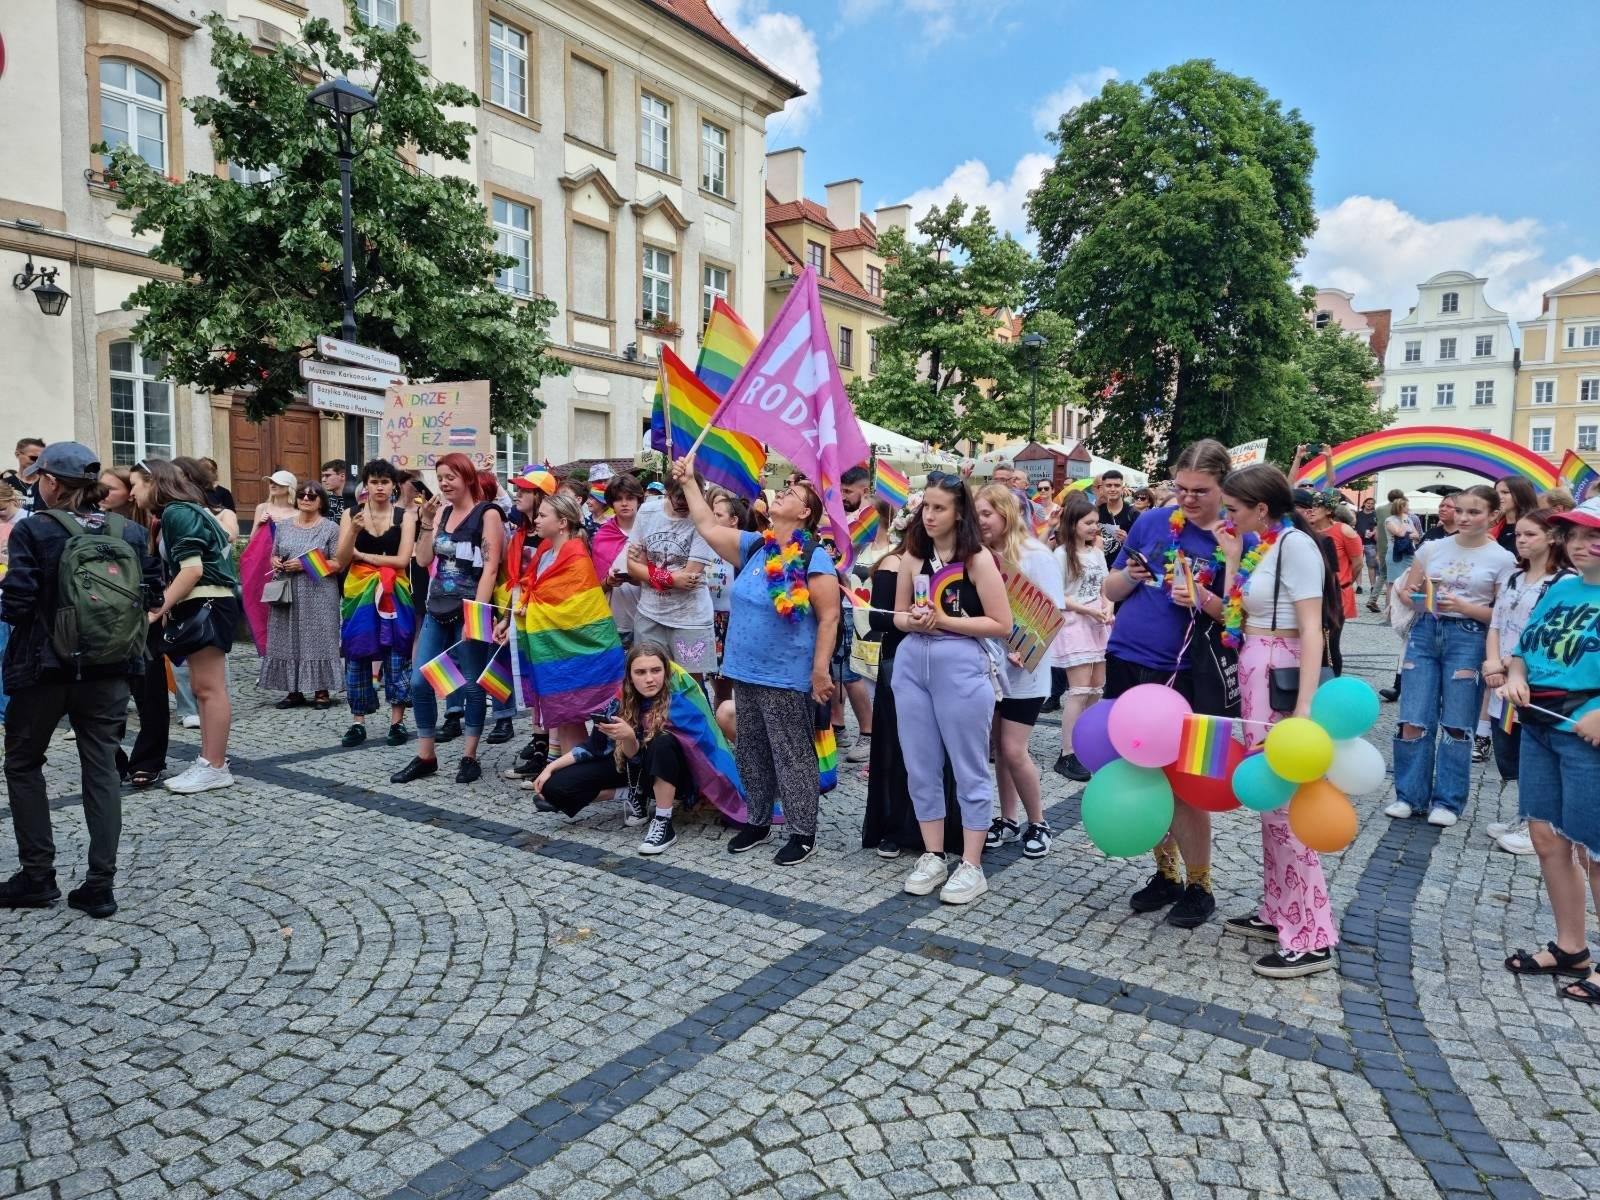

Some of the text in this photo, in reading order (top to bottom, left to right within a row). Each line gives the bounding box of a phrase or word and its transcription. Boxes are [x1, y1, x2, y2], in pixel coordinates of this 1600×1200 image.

[308, 366, 377, 382] Muzeum Karkonoskie
[317, 386, 367, 400] Bazylika Mniejsza
[398, 411, 453, 429] RÓNOŚĆ
[1226, 676, 1236, 689] the
